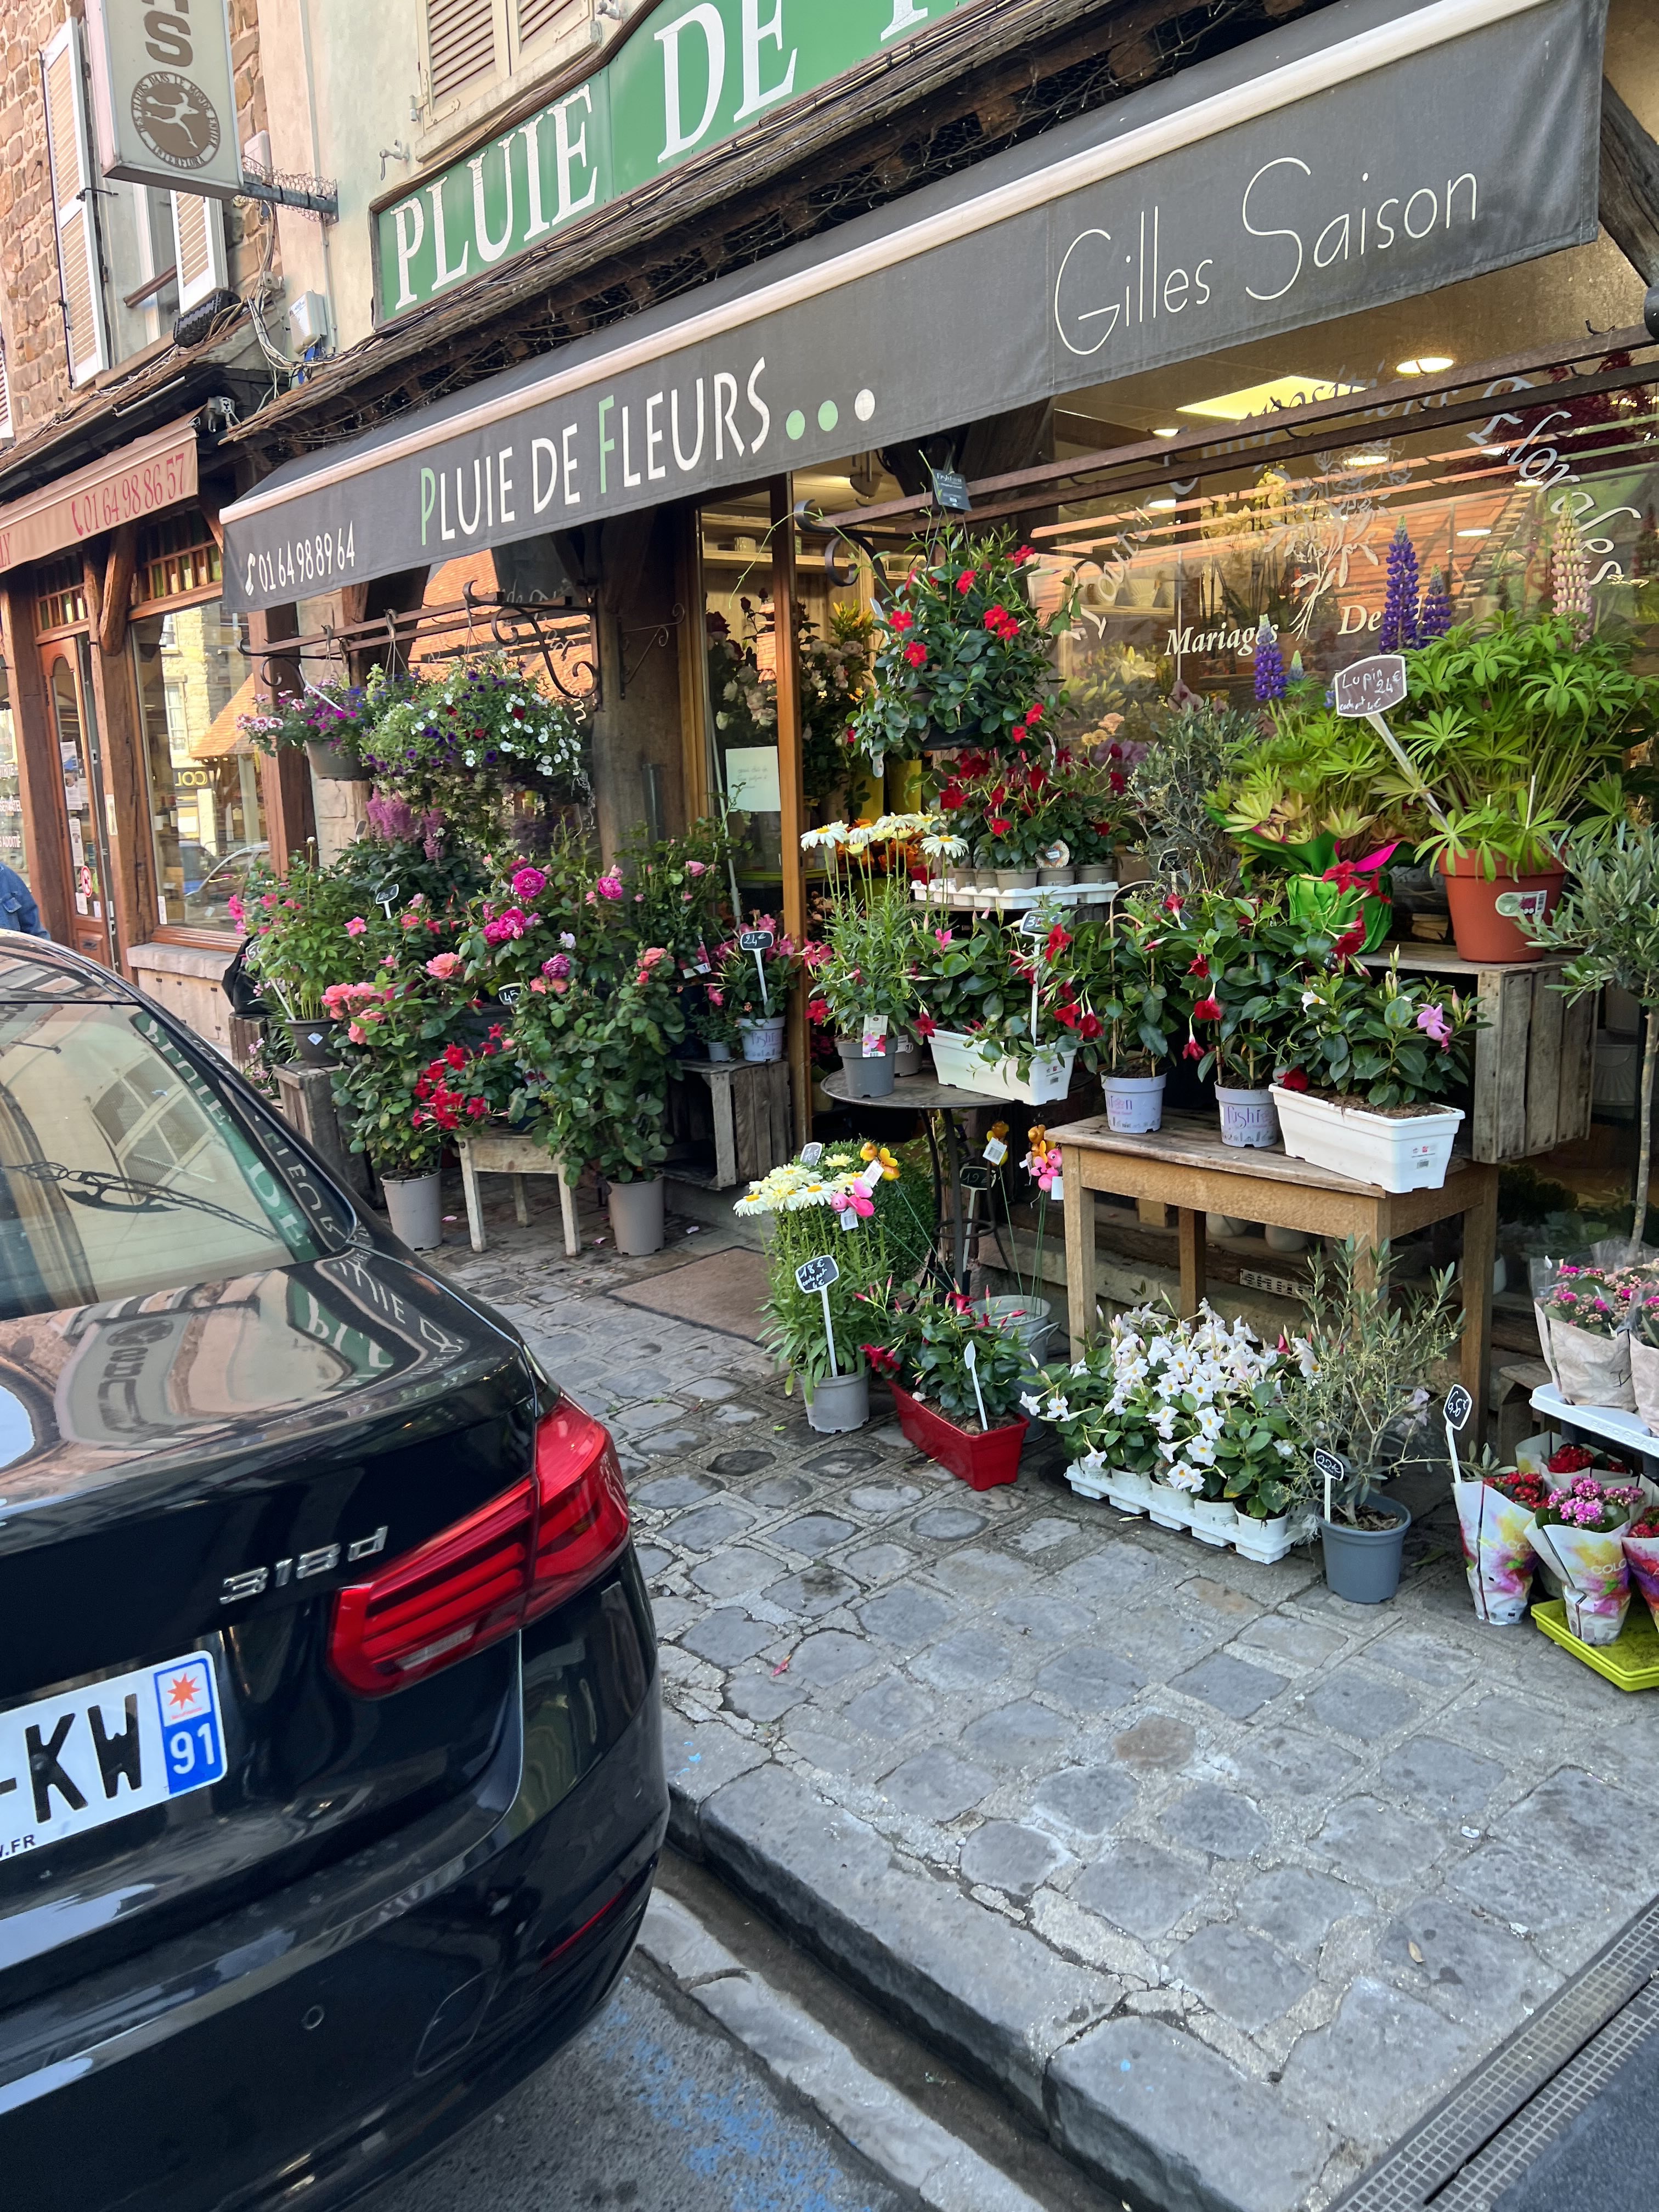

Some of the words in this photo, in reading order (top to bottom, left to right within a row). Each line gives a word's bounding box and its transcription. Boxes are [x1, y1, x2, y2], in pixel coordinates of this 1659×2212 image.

[390, 83, 598, 311] PLUIE
[653, 0, 798, 163] DE
[1054, 206, 1214, 356] Gilles
[1242, 155, 1478, 301] Saison
[420, 446, 517, 546] PLUIE
[531, 422, 582, 515] DE
[170, 1722, 215, 1774] 91
